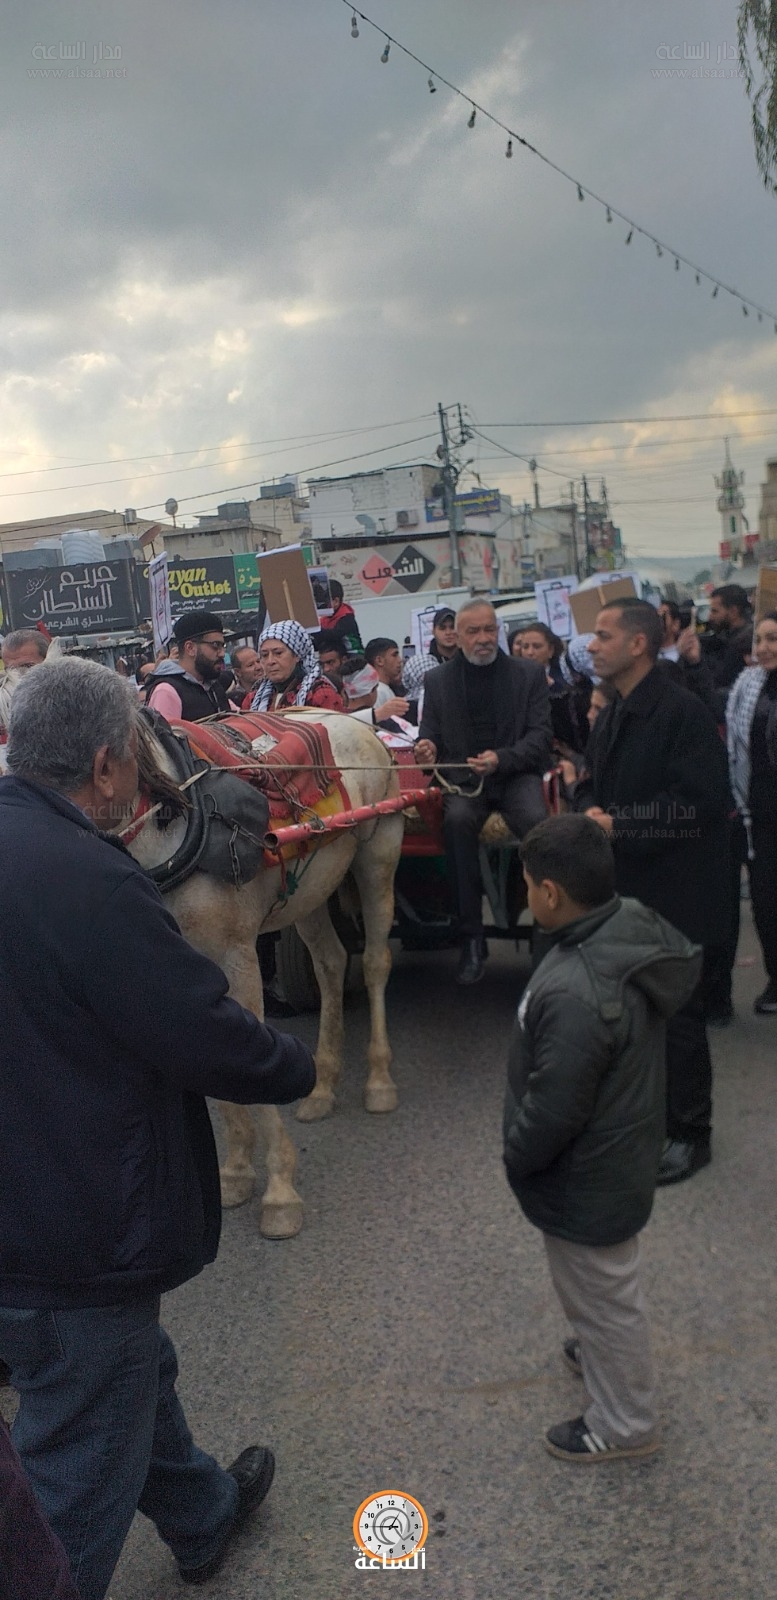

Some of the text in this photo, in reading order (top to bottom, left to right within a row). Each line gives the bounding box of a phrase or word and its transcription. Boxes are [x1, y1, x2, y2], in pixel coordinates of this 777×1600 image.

[60, 566, 118, 593] حريم
[362, 557, 425, 584] الشعب
[22, 583, 113, 621] السلطان
[181, 580, 231, 598] Outlet
